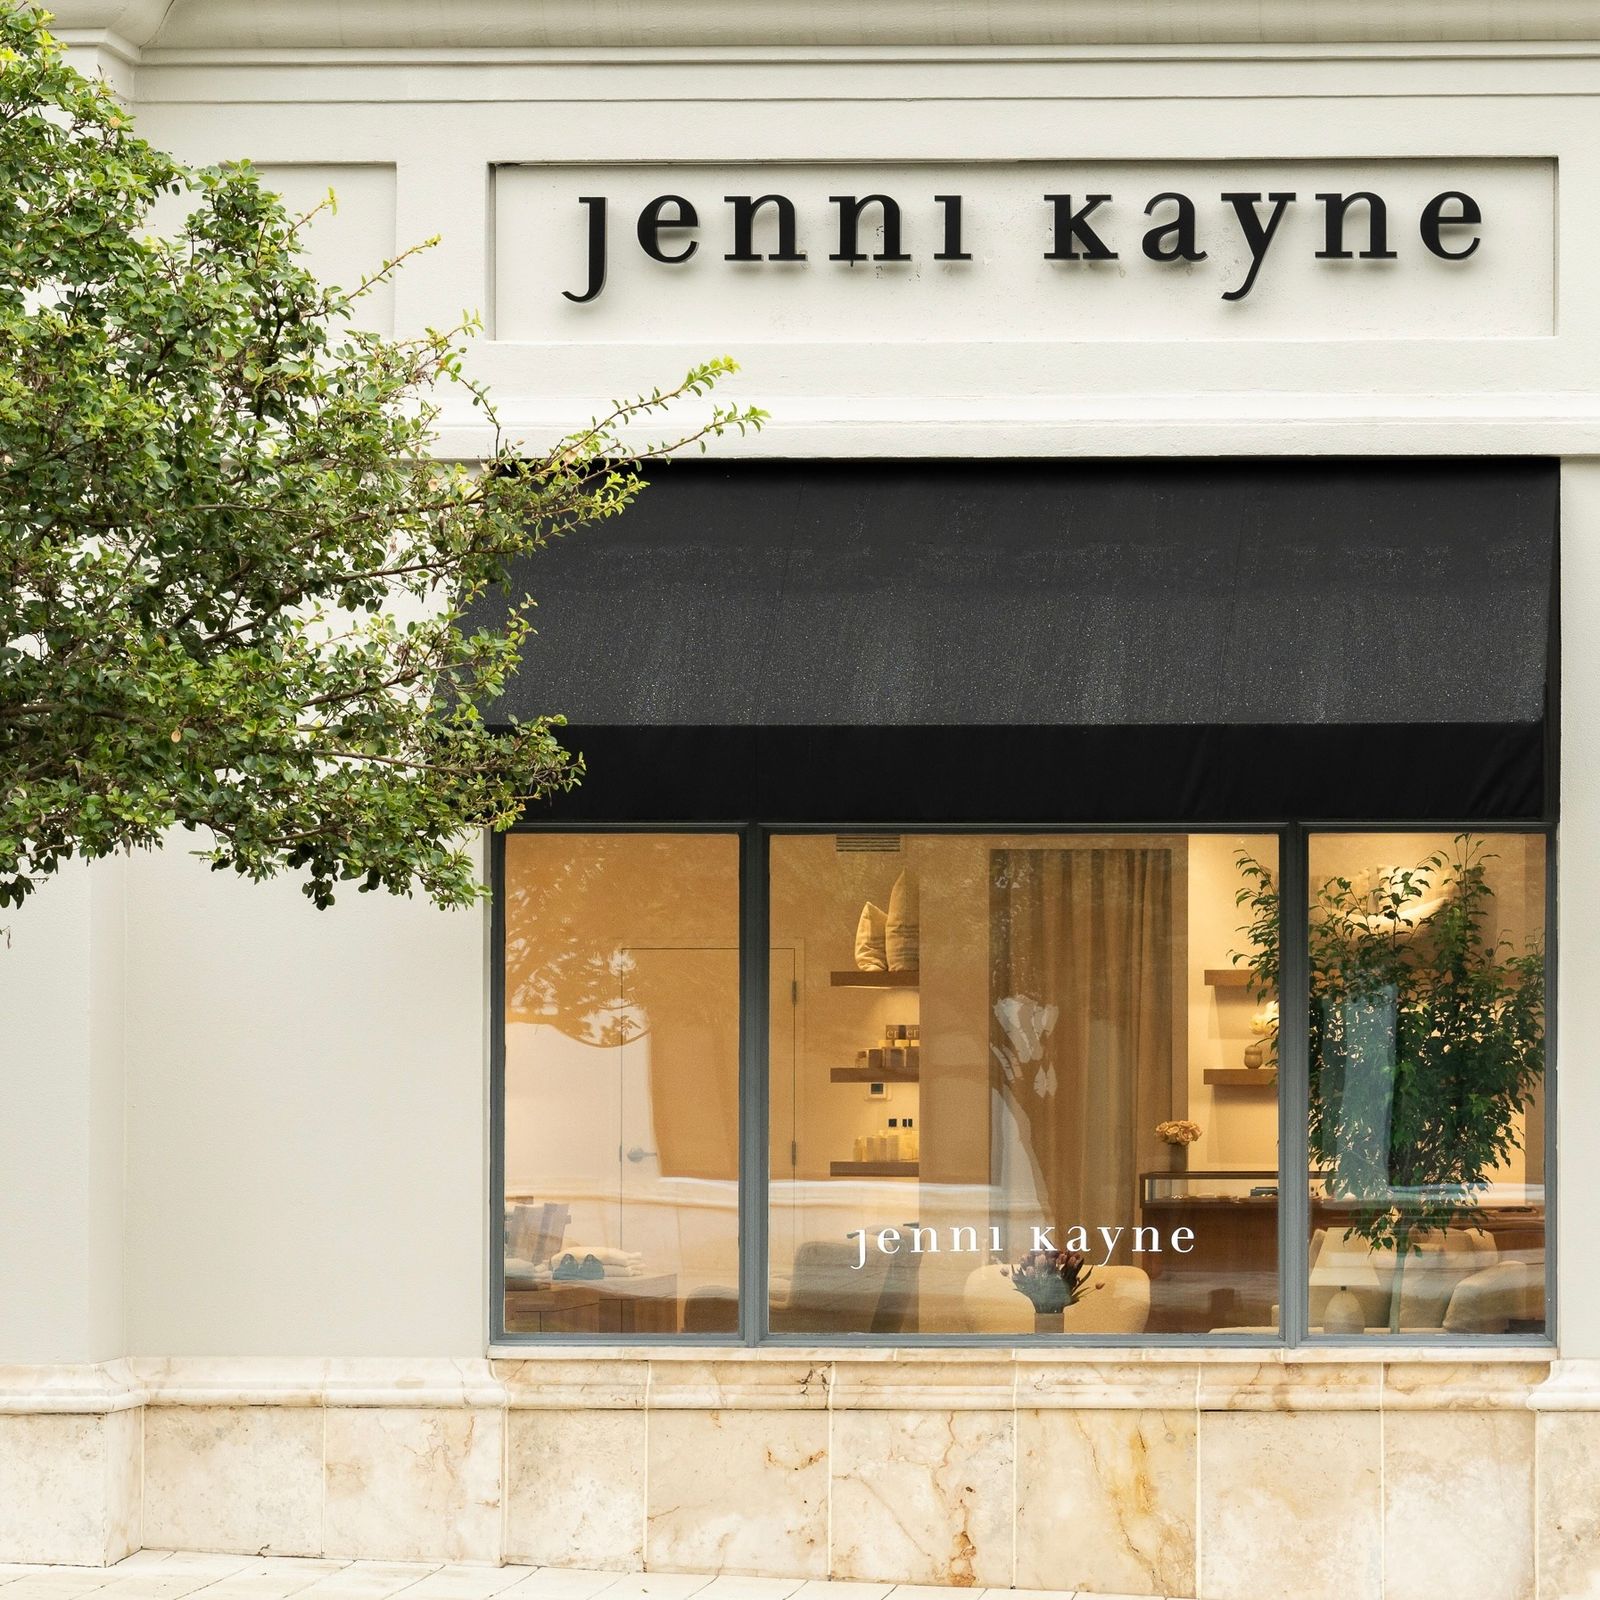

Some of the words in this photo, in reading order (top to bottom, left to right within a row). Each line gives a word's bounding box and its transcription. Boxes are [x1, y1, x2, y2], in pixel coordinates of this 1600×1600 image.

[562, 194, 973, 304] jenni
[1043, 191, 1483, 301] kayne
[850, 1226, 1004, 1269] jenni
[1029, 1225, 1196, 1267] kayne
